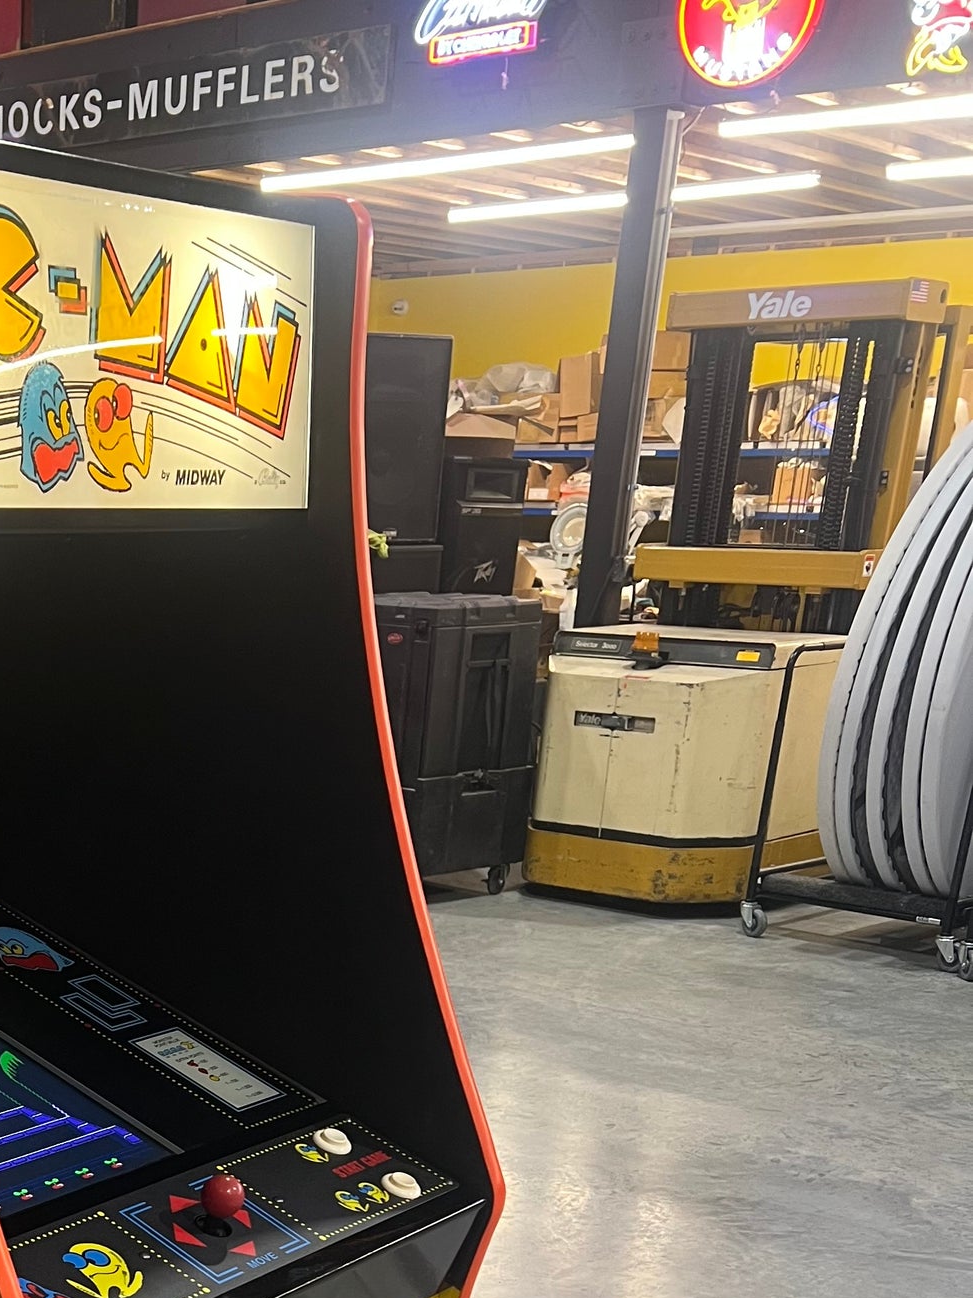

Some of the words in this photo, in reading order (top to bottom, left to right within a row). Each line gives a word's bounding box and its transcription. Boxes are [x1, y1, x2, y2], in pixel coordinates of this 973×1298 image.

[747, 289, 812, 320] Yale
[161, 469, 171, 481] by
[175, 469, 226, 486] MIDWAY
[579, 712, 602, 726] Yale
[245, 1251, 280, 1270] MOVE
